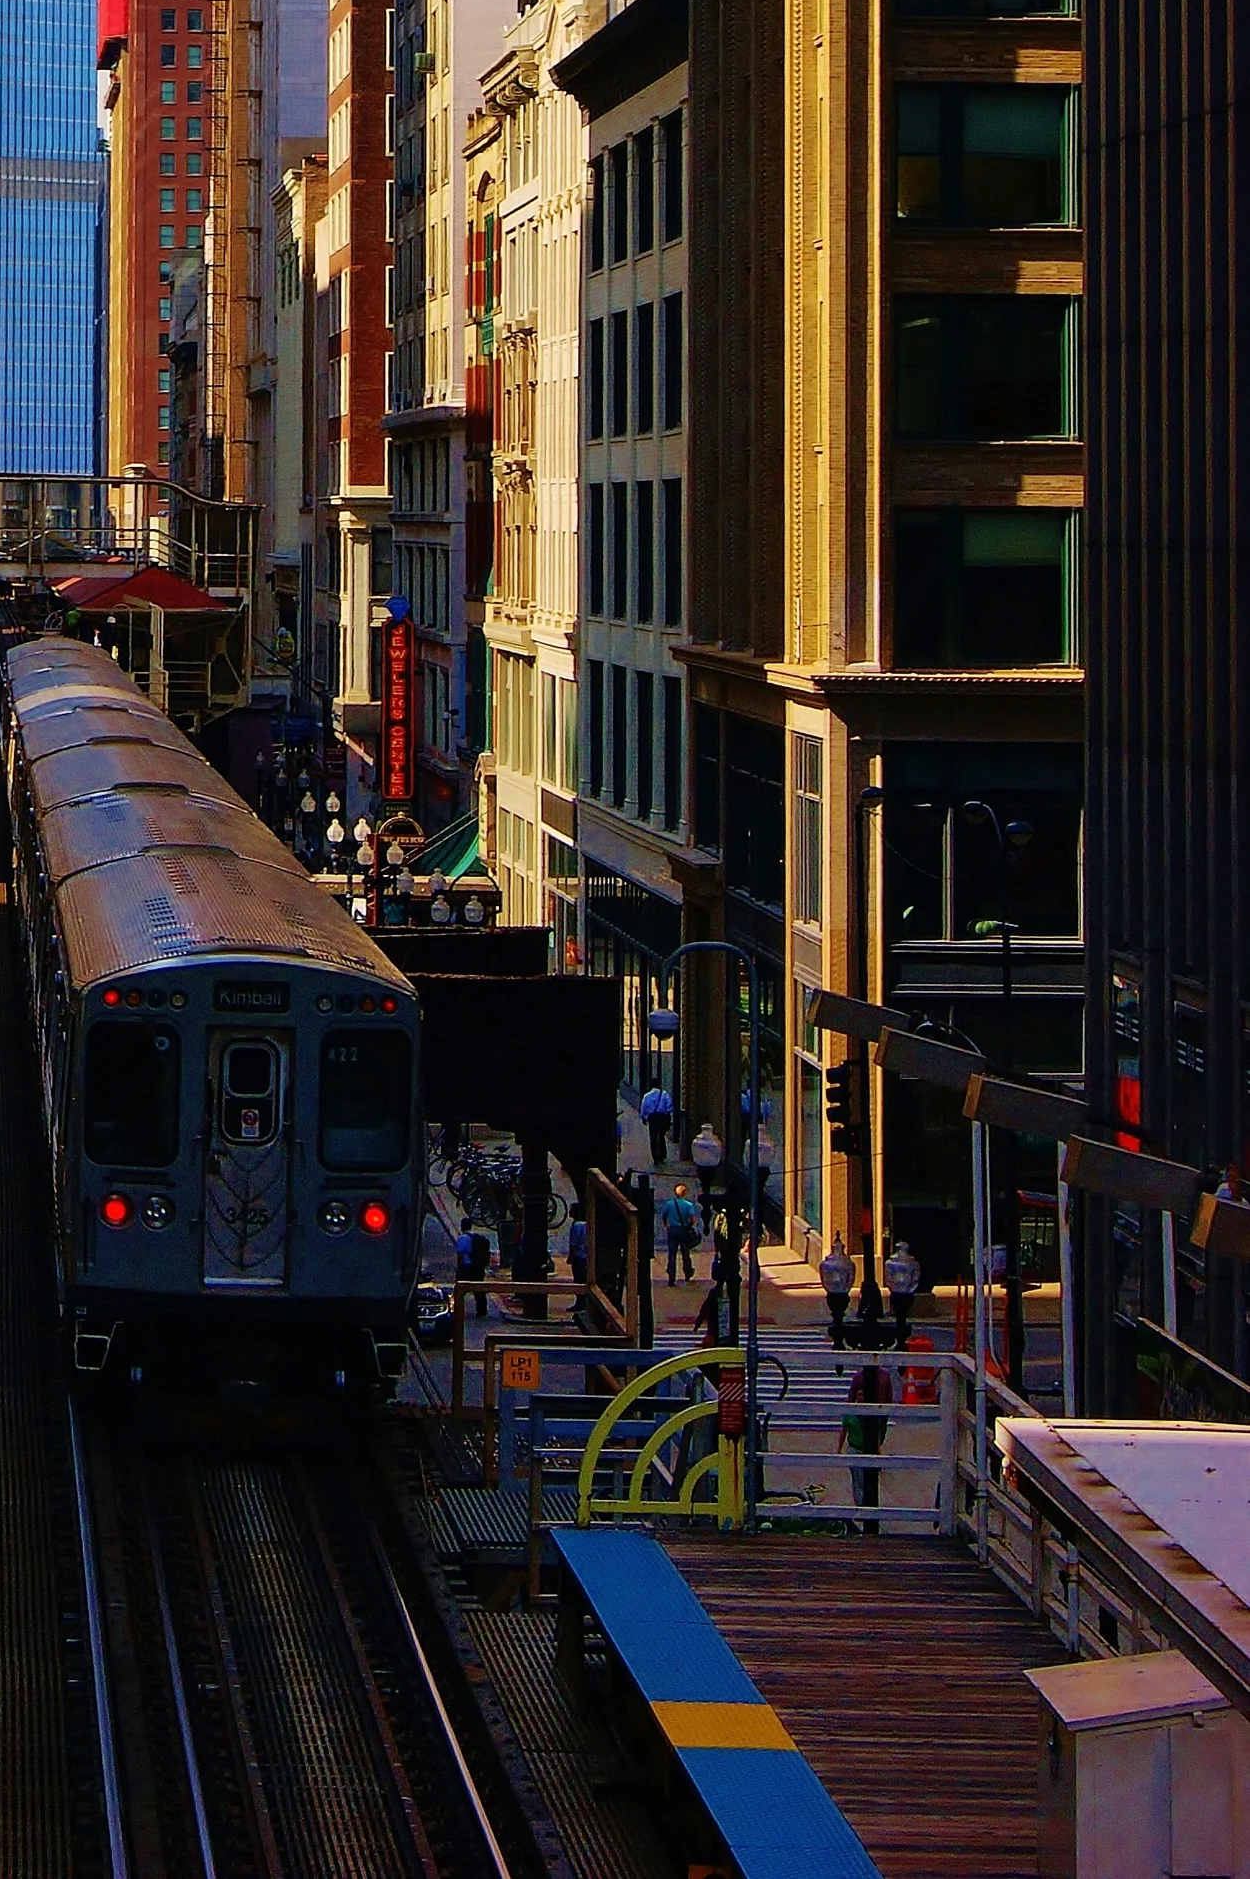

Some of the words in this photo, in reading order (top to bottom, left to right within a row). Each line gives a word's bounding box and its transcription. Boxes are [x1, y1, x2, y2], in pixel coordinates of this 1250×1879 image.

[389, 624, 408, 721] JEWELERS
[389, 725, 407, 797] CENTER
[219, 989, 282, 1006] Kimball
[225, 1206, 269, 1225] 3425
[511, 1357, 532, 1368] LP1
